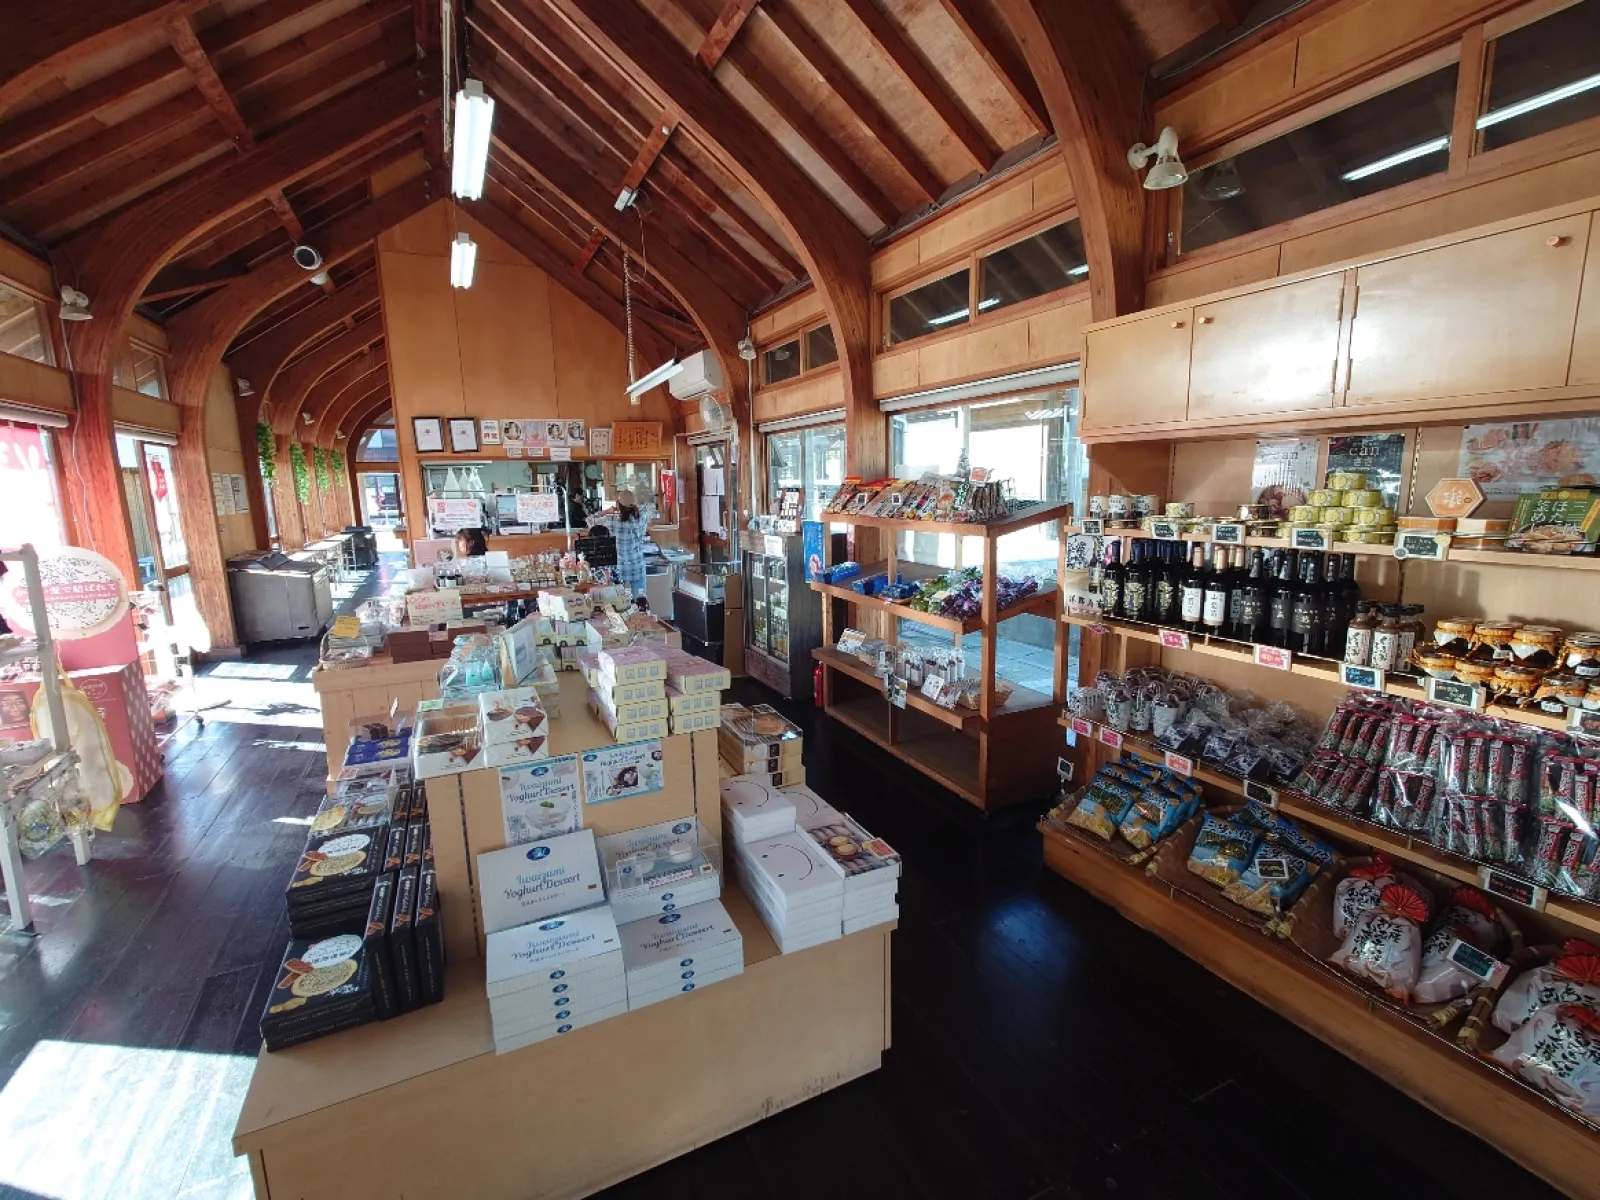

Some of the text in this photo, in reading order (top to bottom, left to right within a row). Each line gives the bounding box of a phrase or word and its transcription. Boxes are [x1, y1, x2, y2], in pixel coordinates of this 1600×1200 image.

[507, 783, 575, 802] Yoghurt Dessert
[503, 873, 581, 900] Yoghurt Dessert
[516, 866, 565, 885] Iwaizumi
[511, 933, 596, 960] Yoghurt Dessert
[640, 924, 715, 949] Yoghurt Dessert
